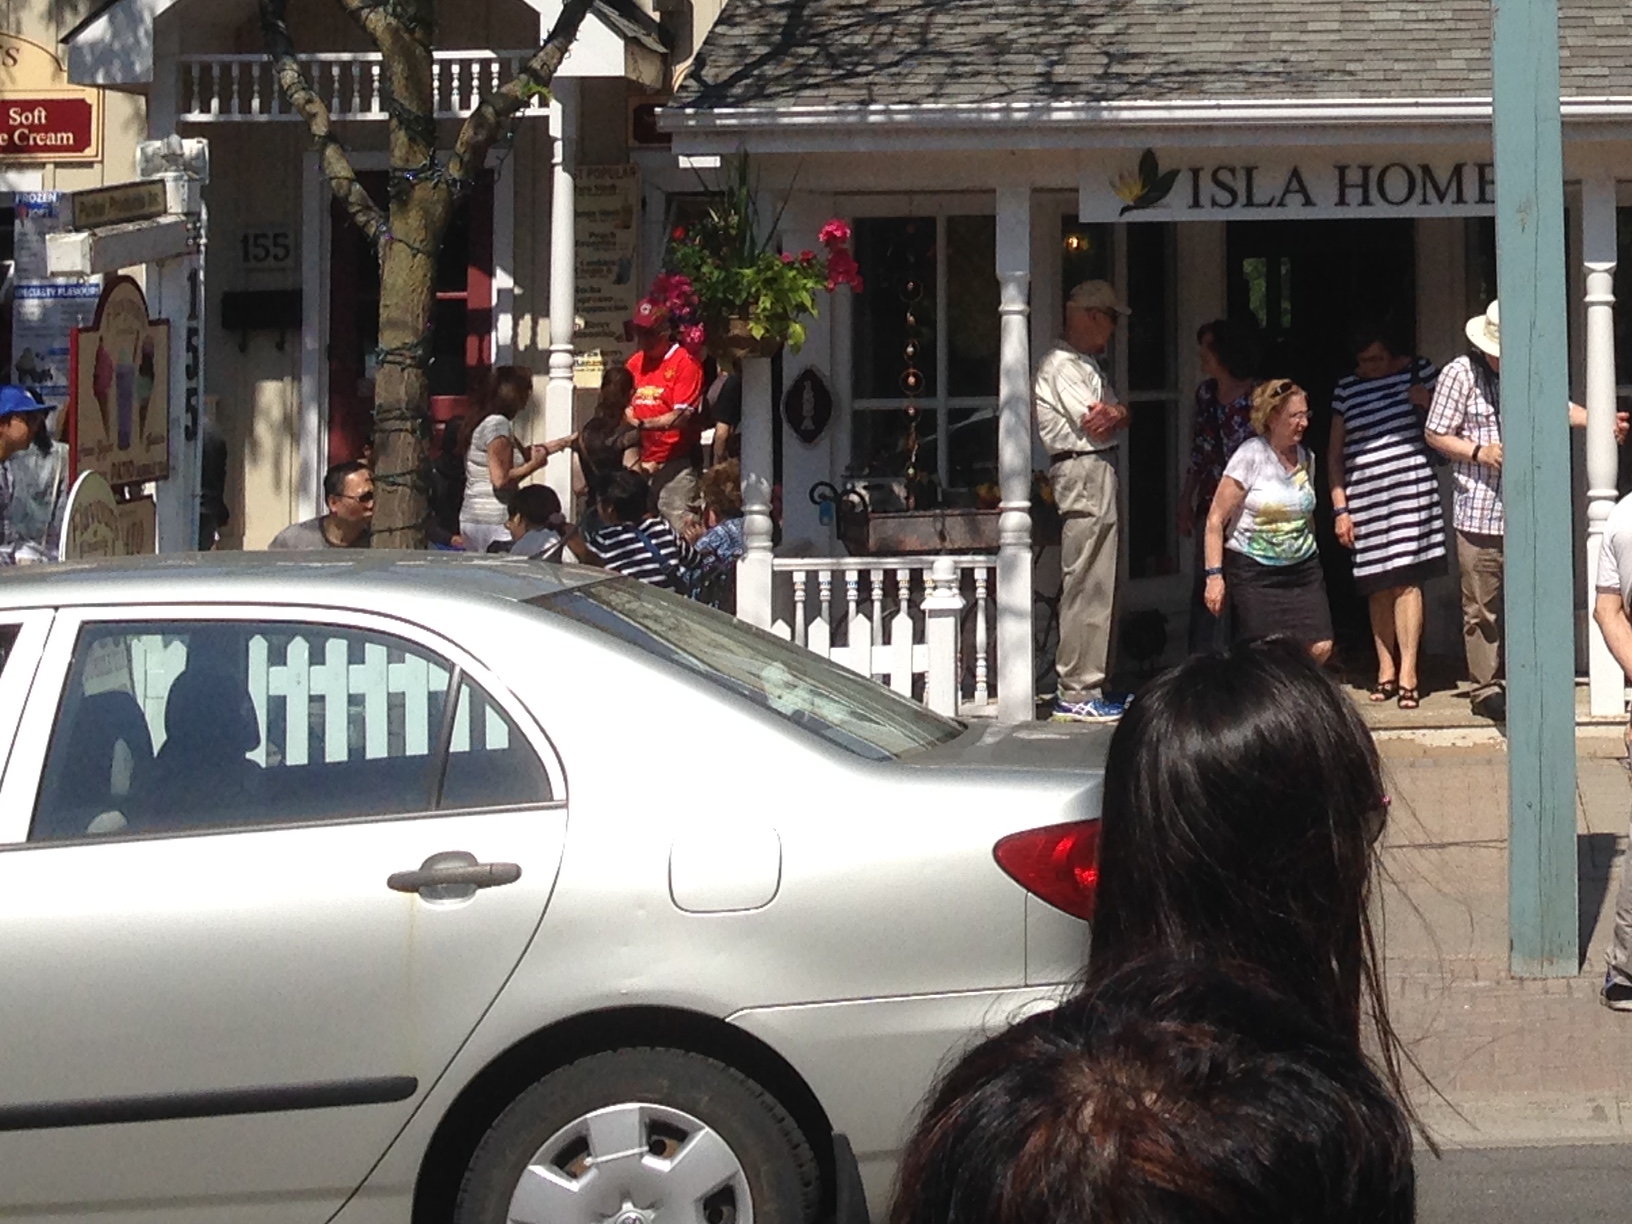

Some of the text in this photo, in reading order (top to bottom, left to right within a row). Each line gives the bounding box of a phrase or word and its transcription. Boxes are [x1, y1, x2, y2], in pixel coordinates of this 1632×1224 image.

[8, 106, 48, 126] Soft
[13, 128, 75, 146] Cream
[1187, 161, 1496, 210] ISLA HOME
[240, 231, 291, 264] 155
[184, 267, 200, 442] 155
